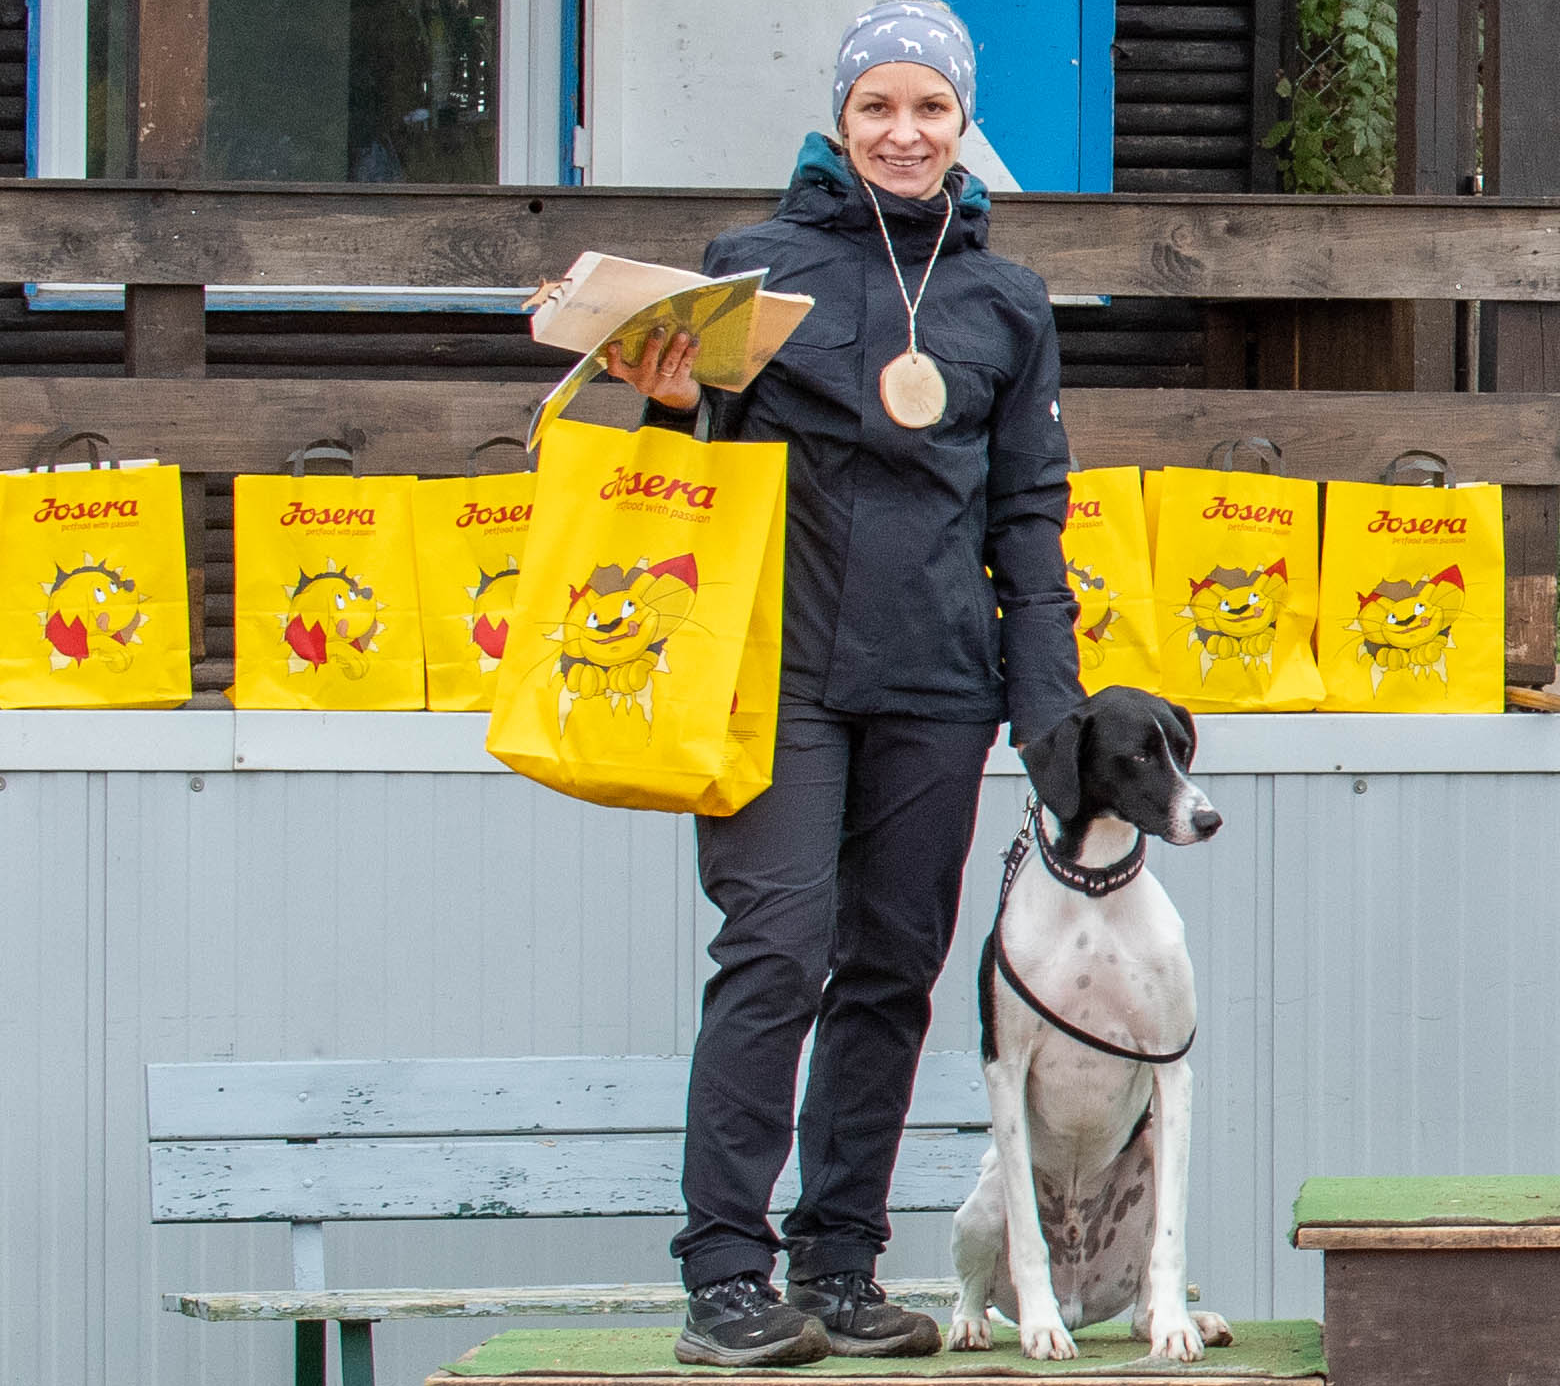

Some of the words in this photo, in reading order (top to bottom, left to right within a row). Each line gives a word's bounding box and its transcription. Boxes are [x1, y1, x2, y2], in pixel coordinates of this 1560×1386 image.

[600, 465, 718, 509] Josera
[34, 498, 138, 523] Josera
[280, 502, 376, 526] Josera
[645, 502, 669, 514] with
[670, 509, 711, 525] passion
[1202, 497, 1294, 526] Josera
[1368, 510, 1467, 534] Josera
